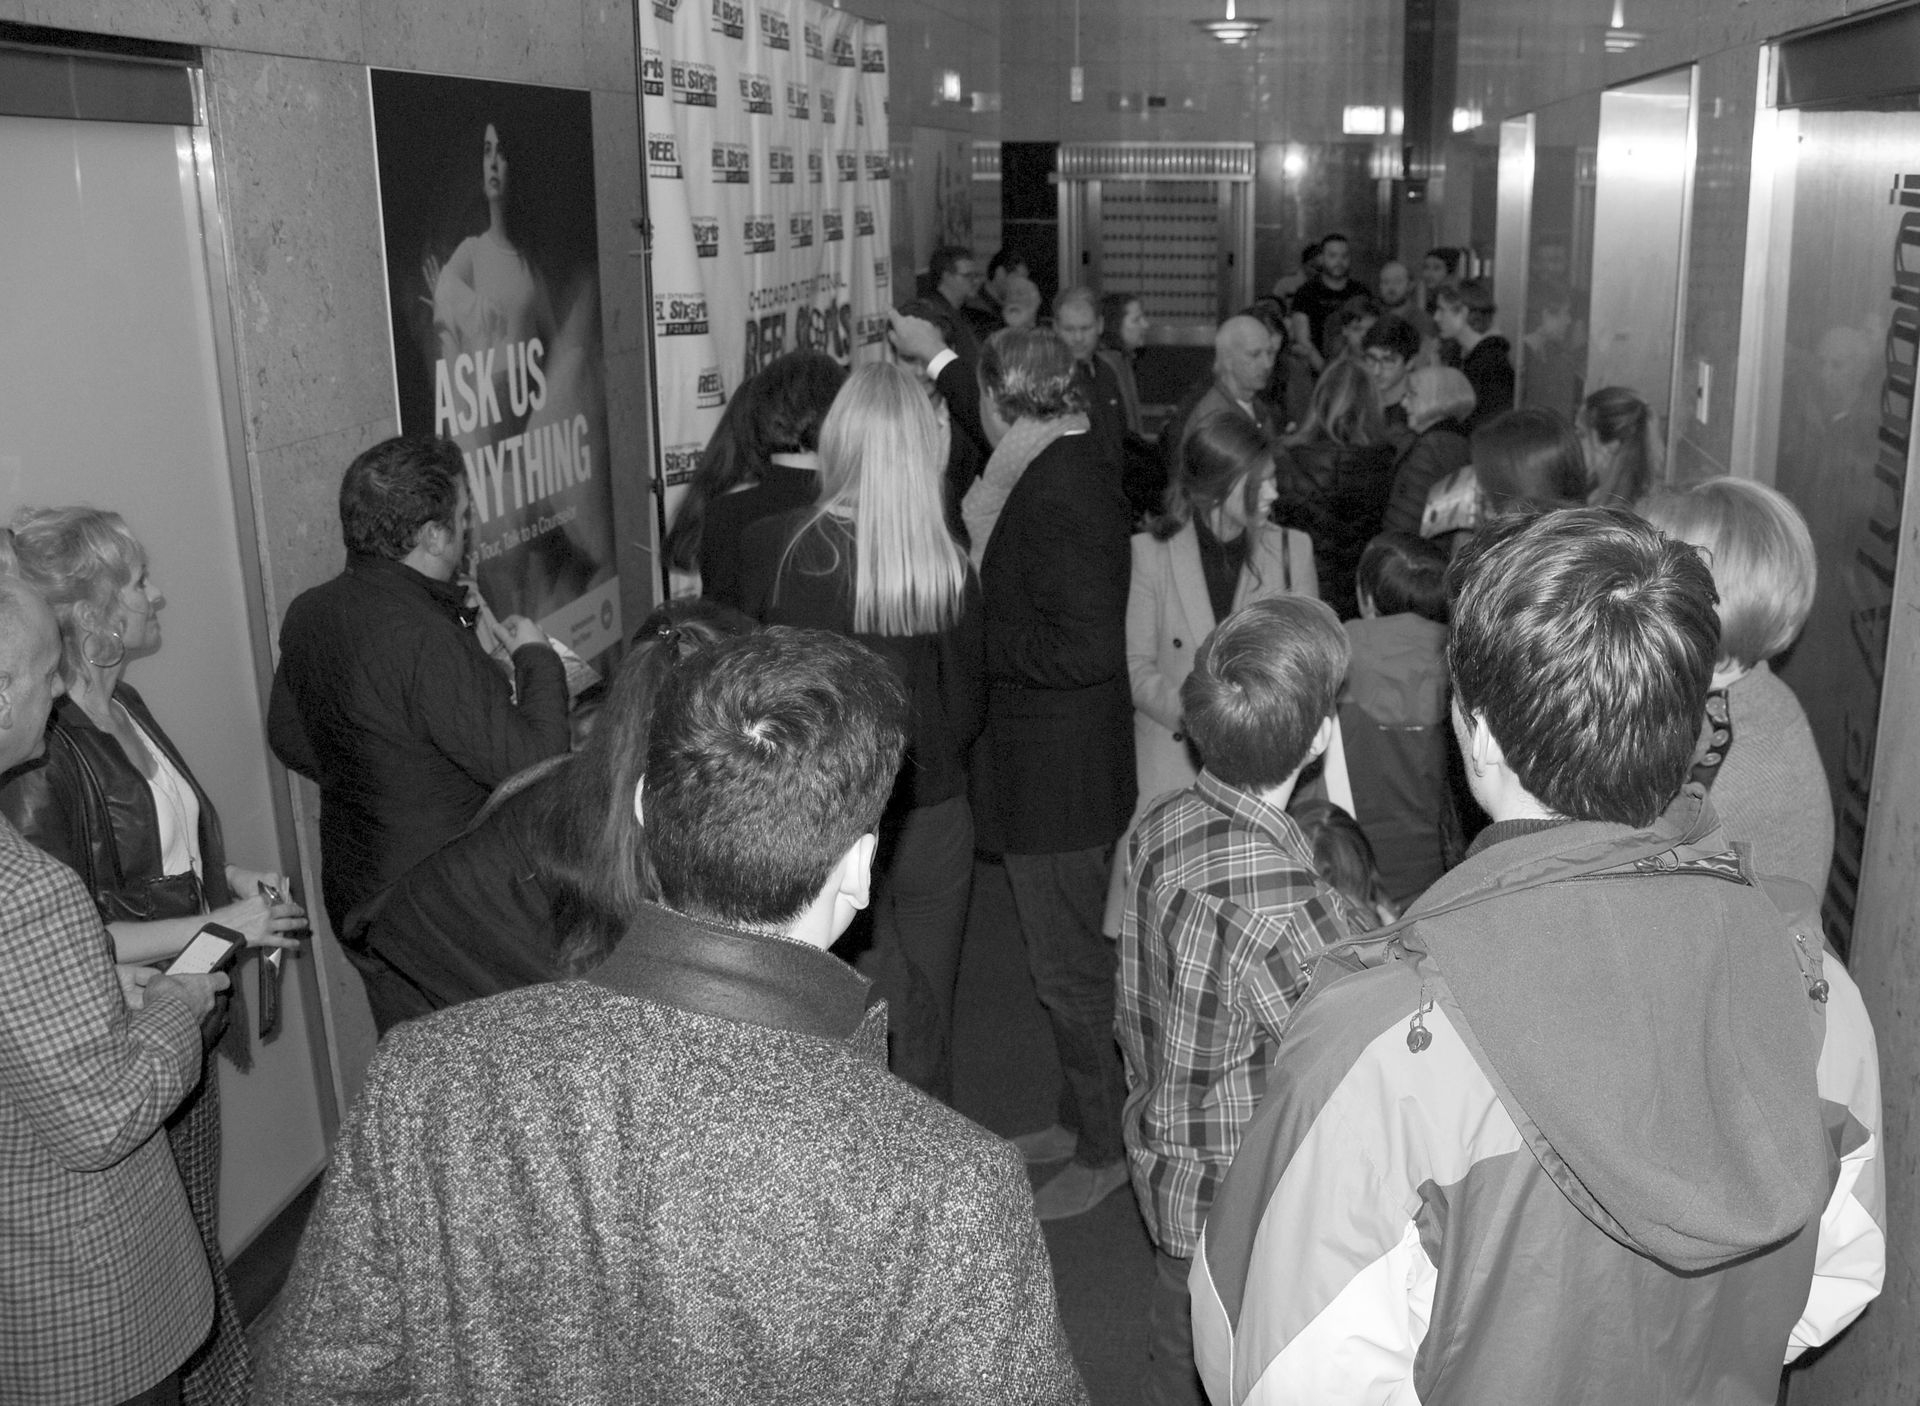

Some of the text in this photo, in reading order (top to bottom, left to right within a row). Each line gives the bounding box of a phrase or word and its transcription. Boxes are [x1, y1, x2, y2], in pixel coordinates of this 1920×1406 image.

[435, 337, 547, 438] ASK US
[463, 413, 592, 523] NYTHING
